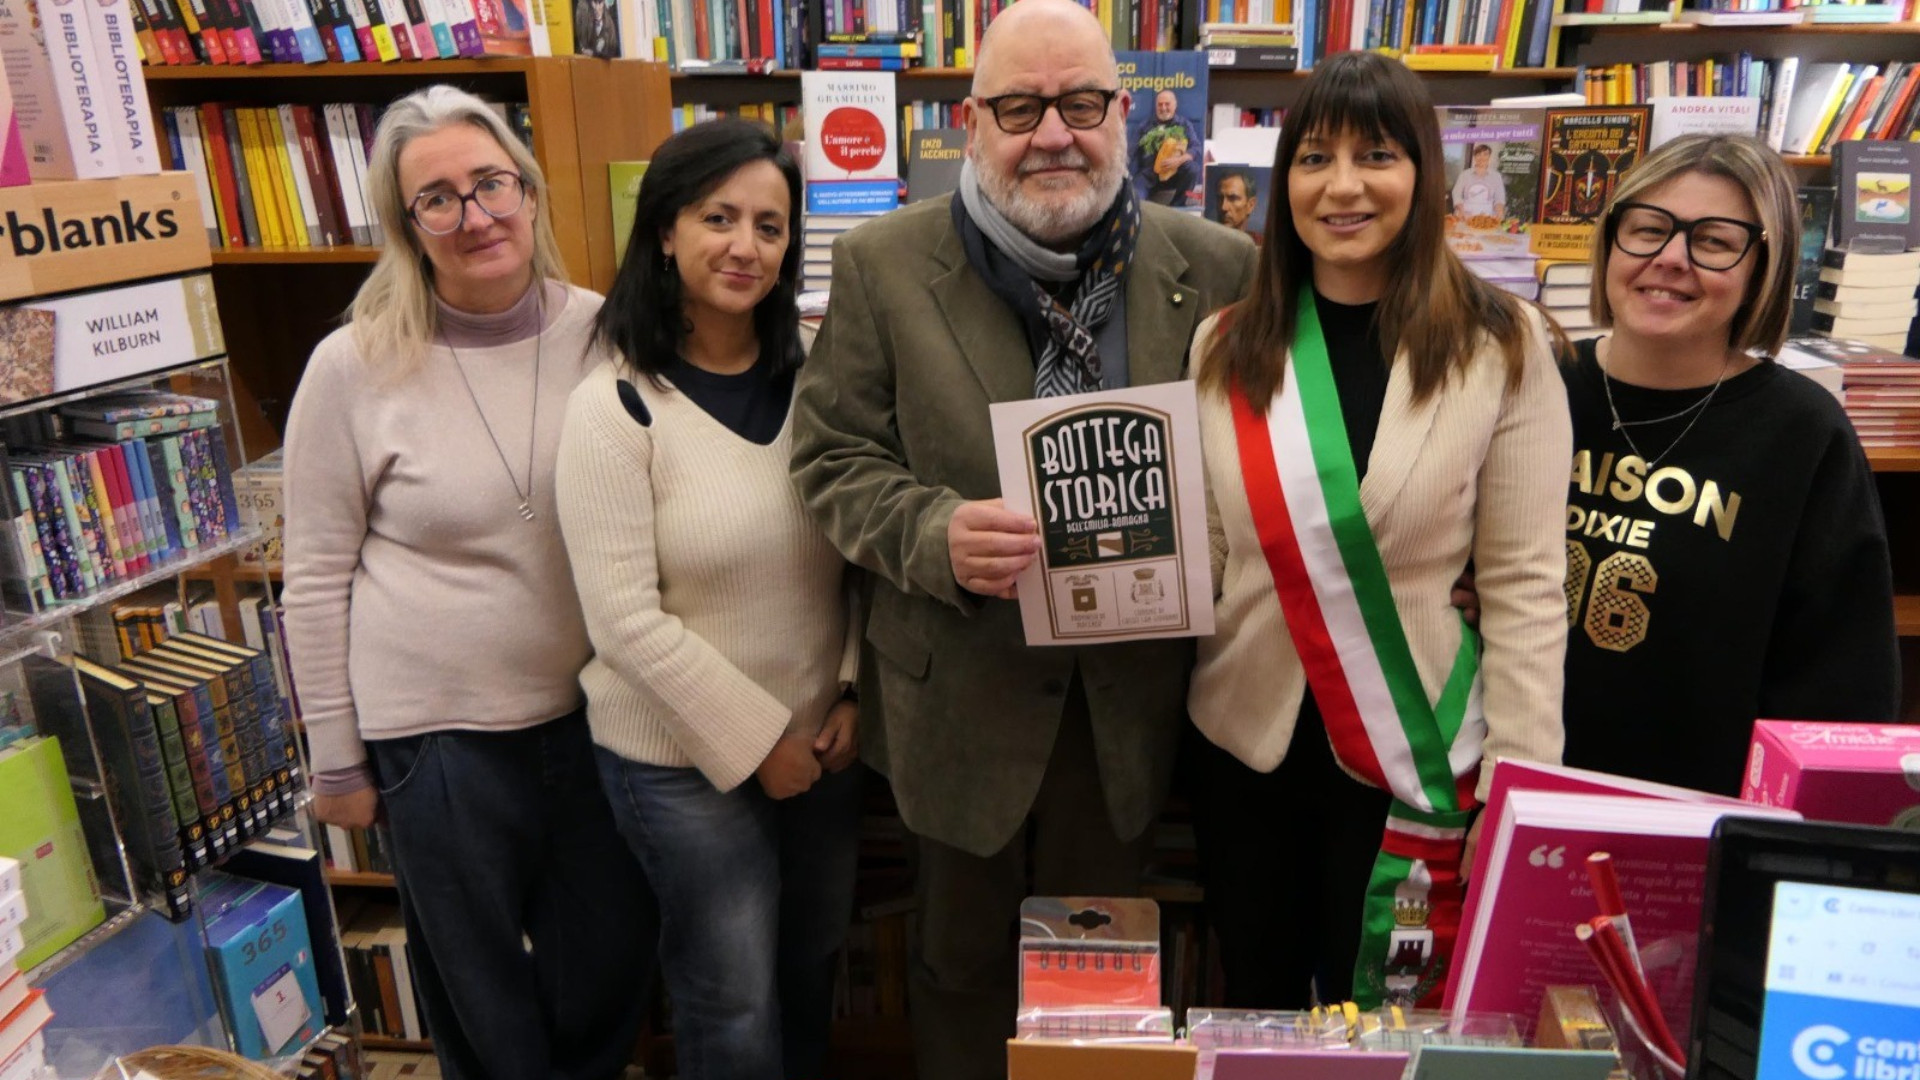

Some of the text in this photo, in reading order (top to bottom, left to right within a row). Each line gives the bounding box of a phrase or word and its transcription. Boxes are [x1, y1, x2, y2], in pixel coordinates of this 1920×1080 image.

[60, 13, 102, 153] BIBLIOTERAPIA
[104, 14, 143, 150] BIBLIOTERAPIA
[827, 83, 877, 92] MASSIMO
[1563, 116, 1602, 125] MARCELLO
[1671, 104, 1751, 114] ANDREA VITALI
[824, 134, 863, 145] L'amore
[921, 139, 942, 149] ENZO
[1496, 130, 1511, 140] per
[1512, 128, 1534, 138] tutti
[840, 146, 848, 156] il
[85, 308, 159, 334] WILLIAM
[93, 330, 161, 356] KILBURN
[1041, 416, 1161, 476] BOTTEGA
[1043, 466, 1166, 523] STORICA
[1570, 450, 1741, 542] AISON
[1566, 504, 1656, 549] DIXIE
[241, 918, 287, 966] 365
[1856, 1036, 1920, 1061] cen
